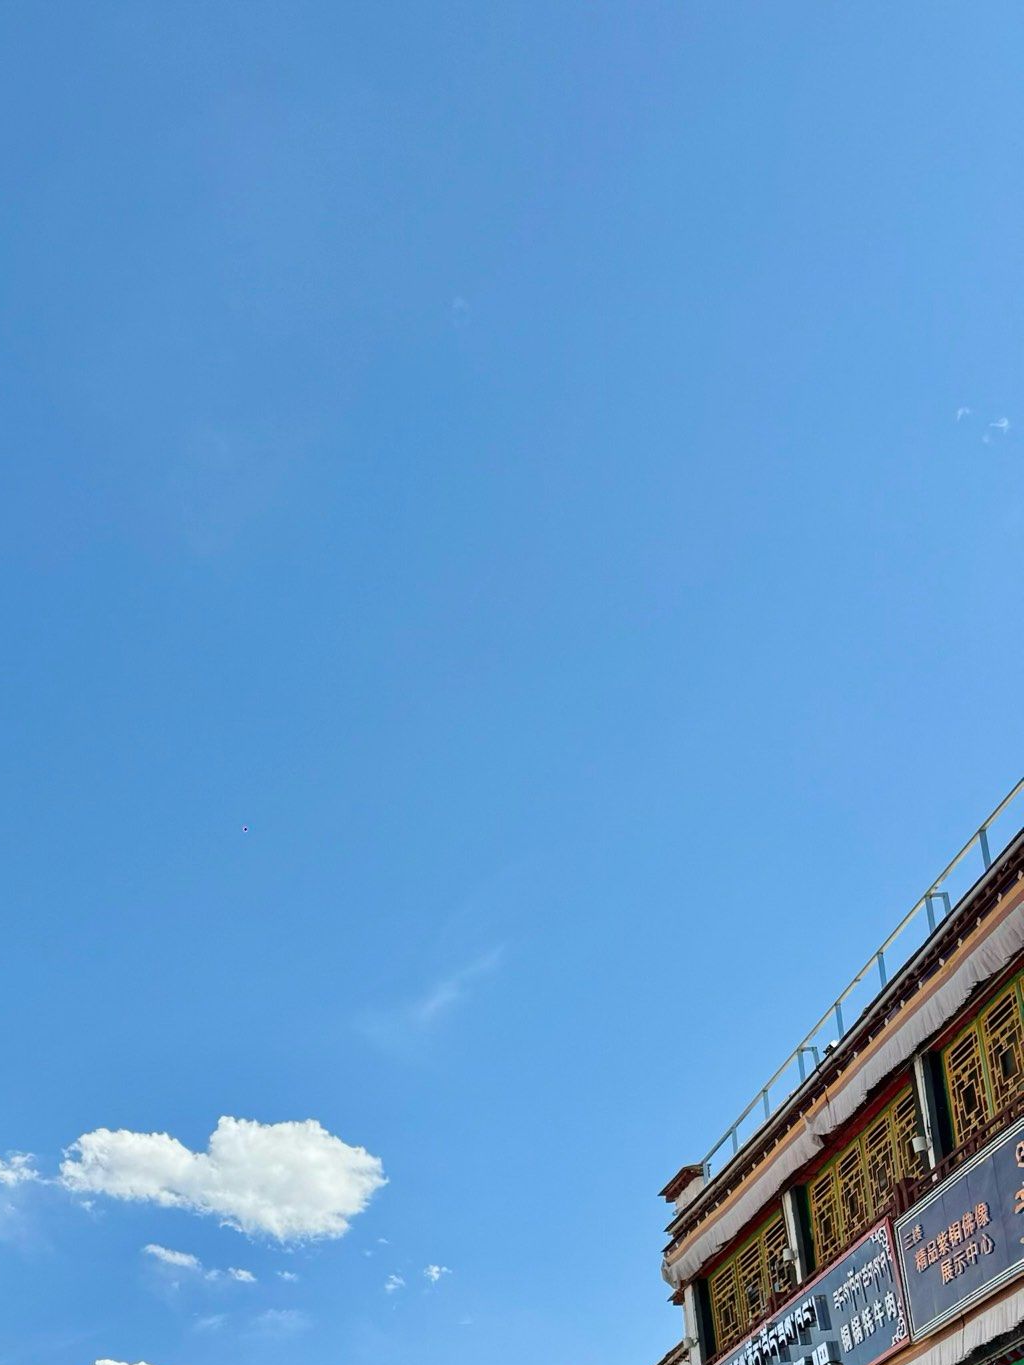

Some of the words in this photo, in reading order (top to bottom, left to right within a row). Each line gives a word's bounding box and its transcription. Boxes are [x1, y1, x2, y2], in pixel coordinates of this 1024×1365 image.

[903, 1224, 924, 1250] 三楼
[914, 1202, 991, 1273] 精品紫铜佛像
[940, 1234, 993, 1285] 展示中心
